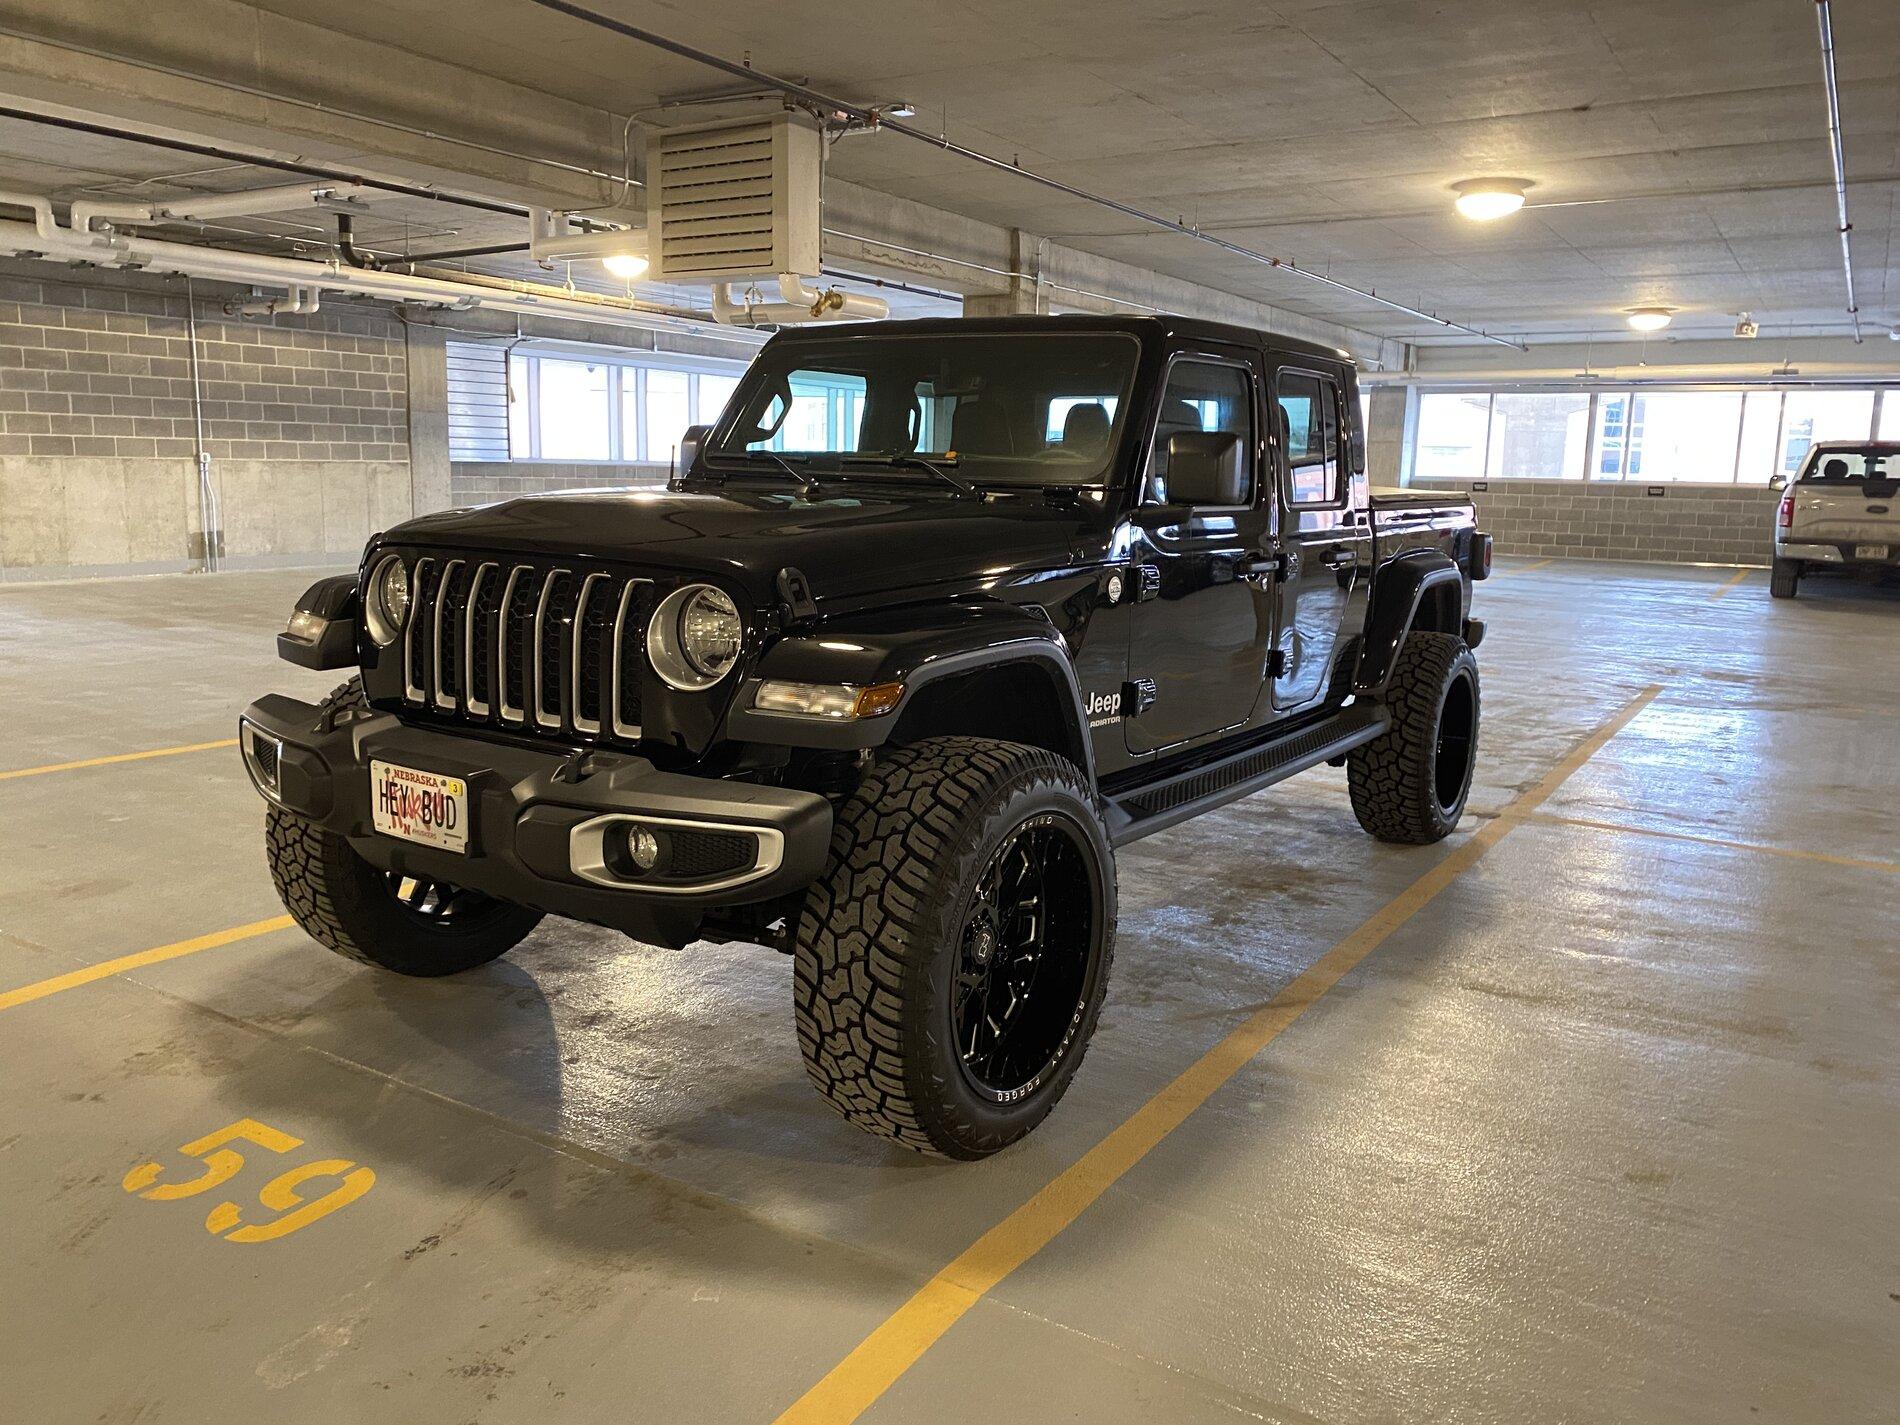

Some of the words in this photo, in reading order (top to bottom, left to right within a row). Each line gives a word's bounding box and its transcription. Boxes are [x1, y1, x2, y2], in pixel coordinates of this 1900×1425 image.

[1083, 691, 1121, 715] Jeep
[1089, 715, 1121, 728] ADIATOR
[393, 768, 438, 787] NEBRASKA
[453, 783, 459, 793] 3
[379, 779, 408, 818] HEY
[422, 790, 456, 830] BUD
[1052, 1000, 1085, 1068] ROTARY
[997, 1076, 1040, 1102] FORGED
[122, 1118, 376, 1243] 59
